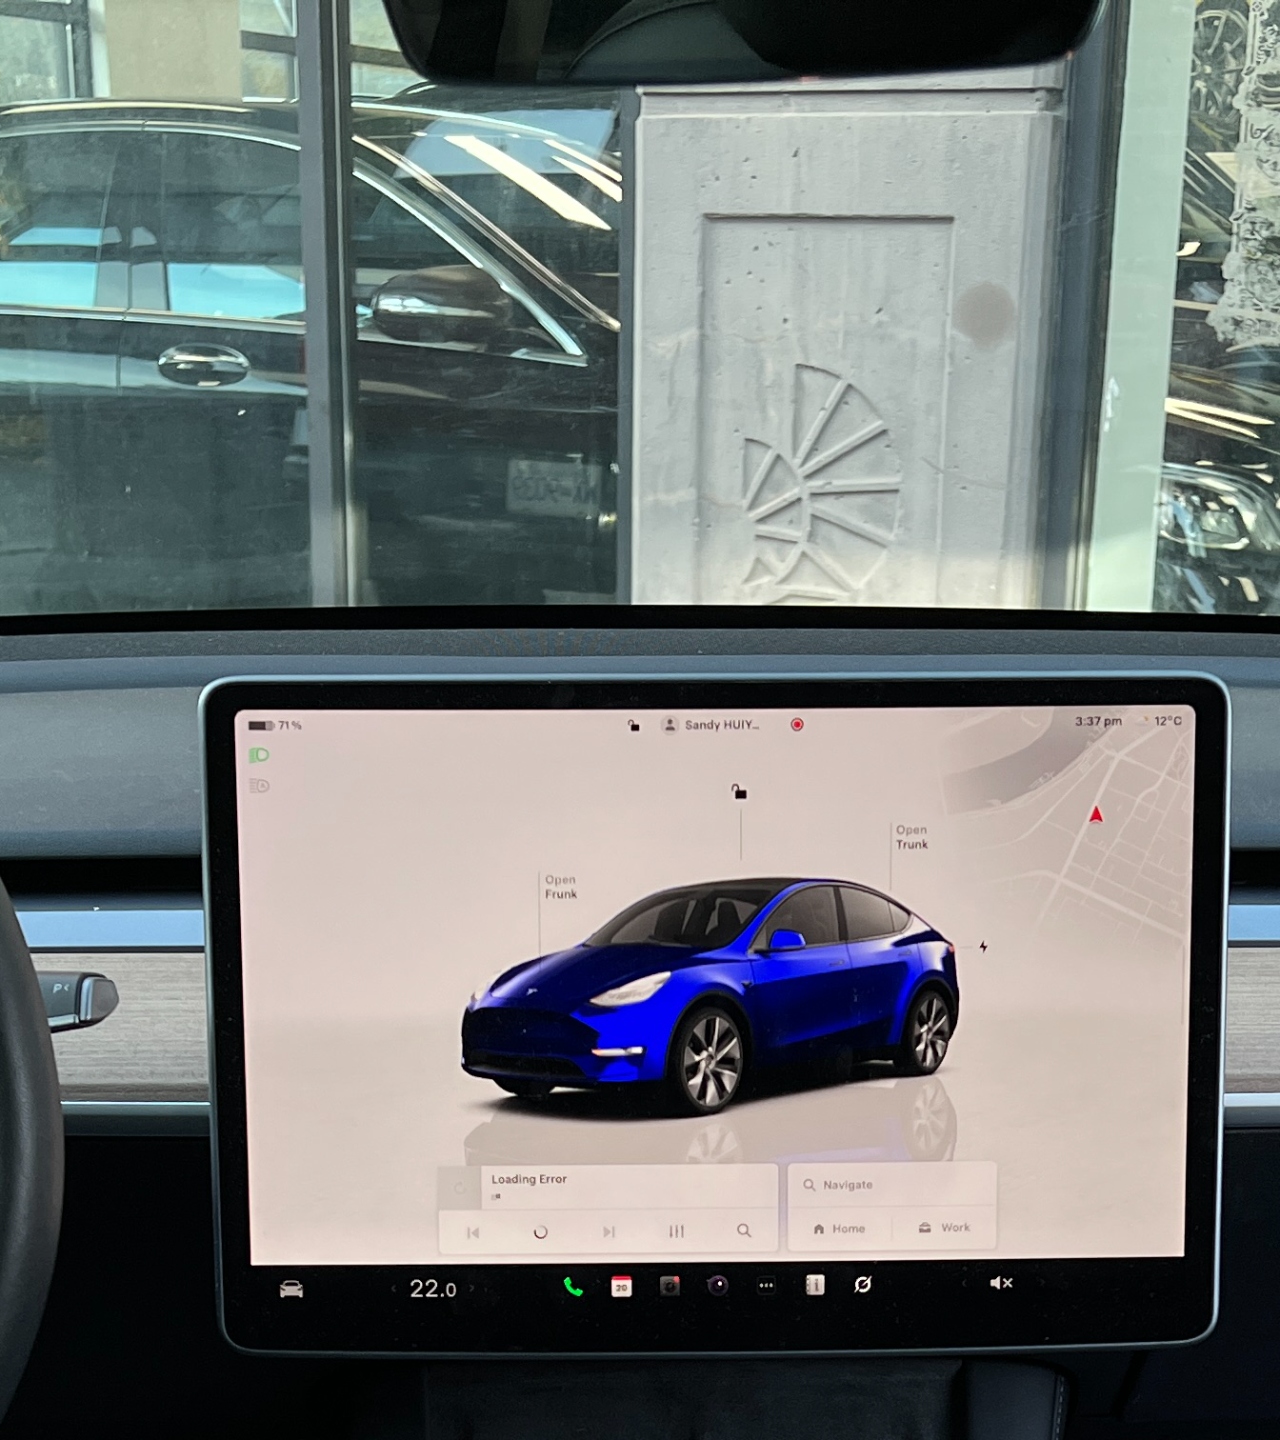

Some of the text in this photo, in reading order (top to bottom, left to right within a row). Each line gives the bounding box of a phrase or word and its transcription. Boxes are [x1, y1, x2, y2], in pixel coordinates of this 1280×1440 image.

[277, 719, 302, 731] 71%
[685, 719, 720, 733] Sandy
[1074, 715, 1123, 729] 3:37 pm
[896, 824, 927, 838] Open
[896, 838, 929, 850] Trunk
[545, 875, 577, 887] Open
[545, 888, 578, 900] Frunk
[491, 1173, 568, 1187] Loading Error
[823, 1179, 874, 1192] Navigate
[833, 1223, 866, 1235] Home
[942, 1222, 971, 1233] Work
[410, 1279, 457, 1298] 22.0
